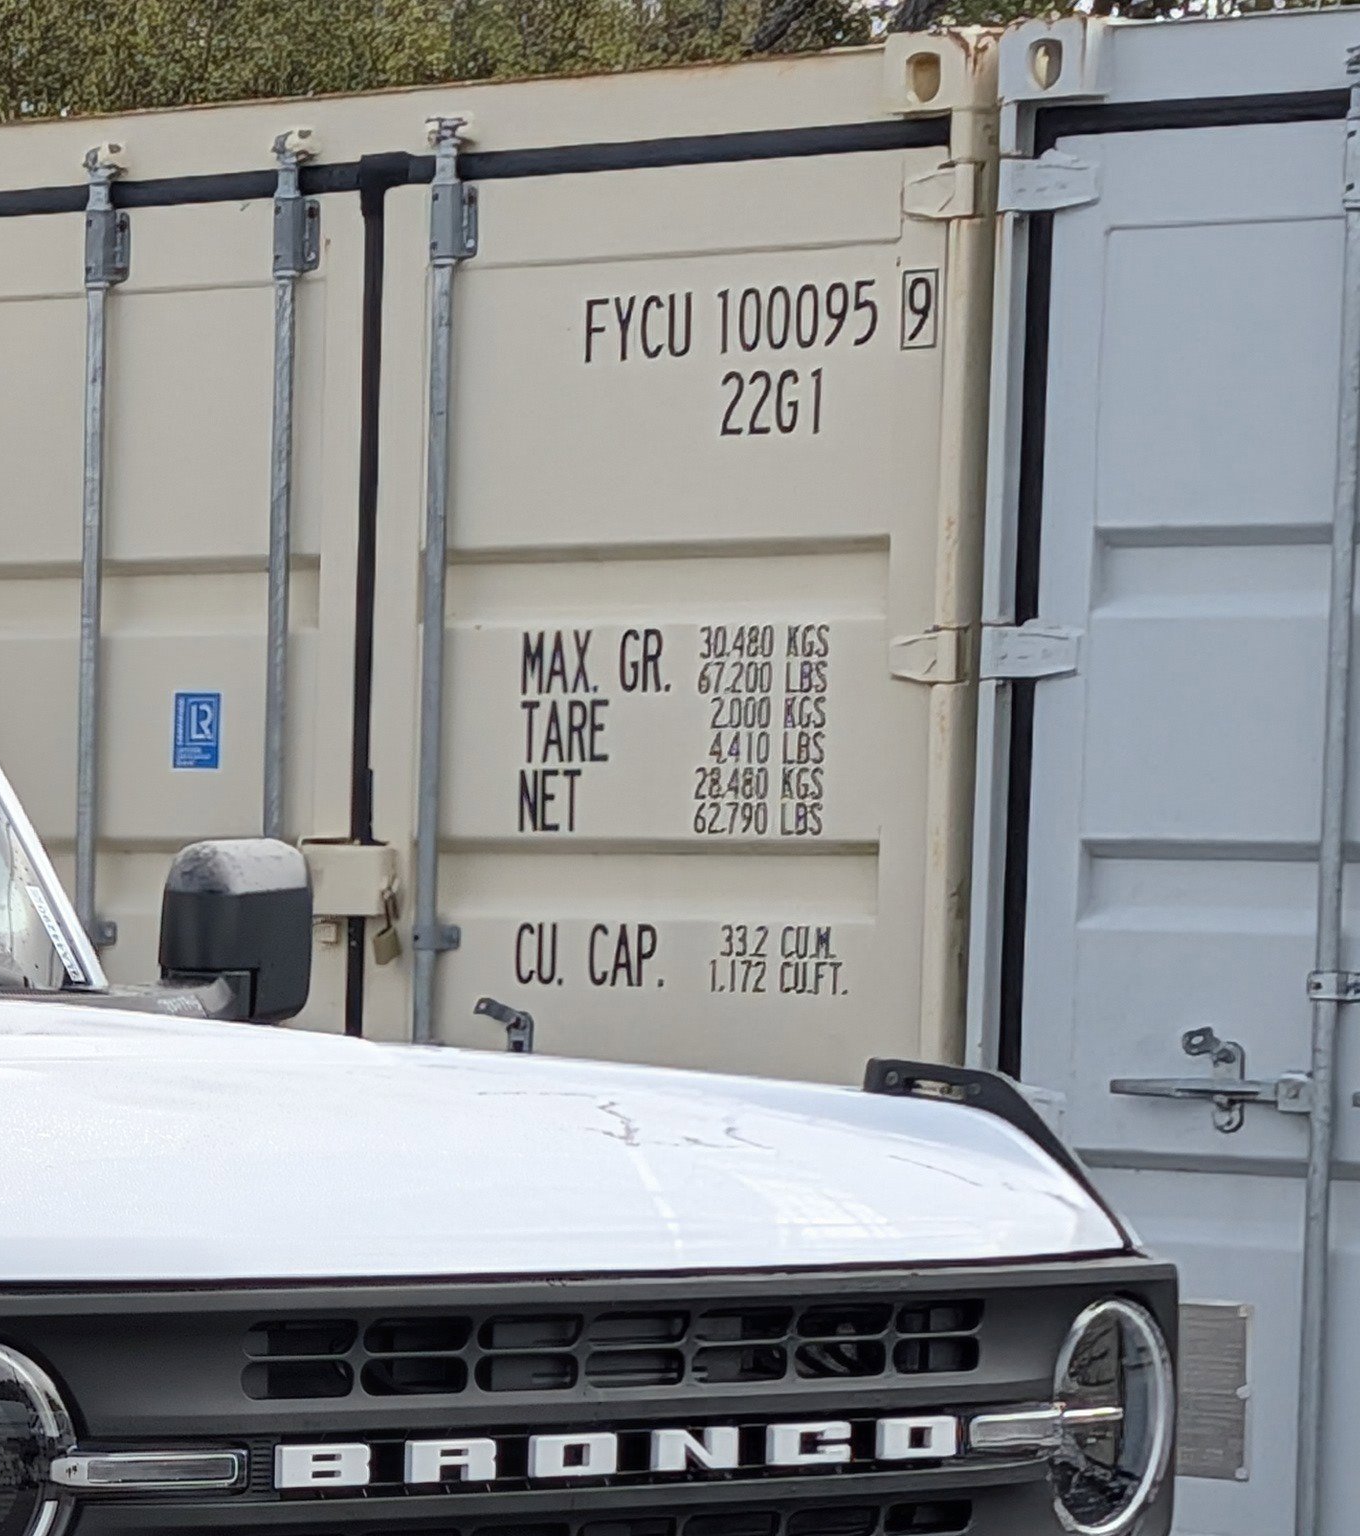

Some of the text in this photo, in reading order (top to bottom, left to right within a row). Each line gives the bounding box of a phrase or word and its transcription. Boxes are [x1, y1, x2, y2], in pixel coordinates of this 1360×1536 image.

[584, 276, 933, 363] FYCU 100095 9
[720, 367, 823, 436] 22G1
[521, 628, 671, 694] MAX. GR.
[786, 624, 830, 658] KGS
[785, 661, 828, 693] LBS
[520, 699, 610, 763] TARE
[783, 696, 827, 729] KGS
[782, 731, 825, 764] LBS
[518, 769, 582, 833] NET
[781, 767, 824, 800] KGS
[780, 802, 824, 836] LBS
[515, 922, 664, 987] CU. CAP.
[274, 1415, 959, 1489] BRONCO
